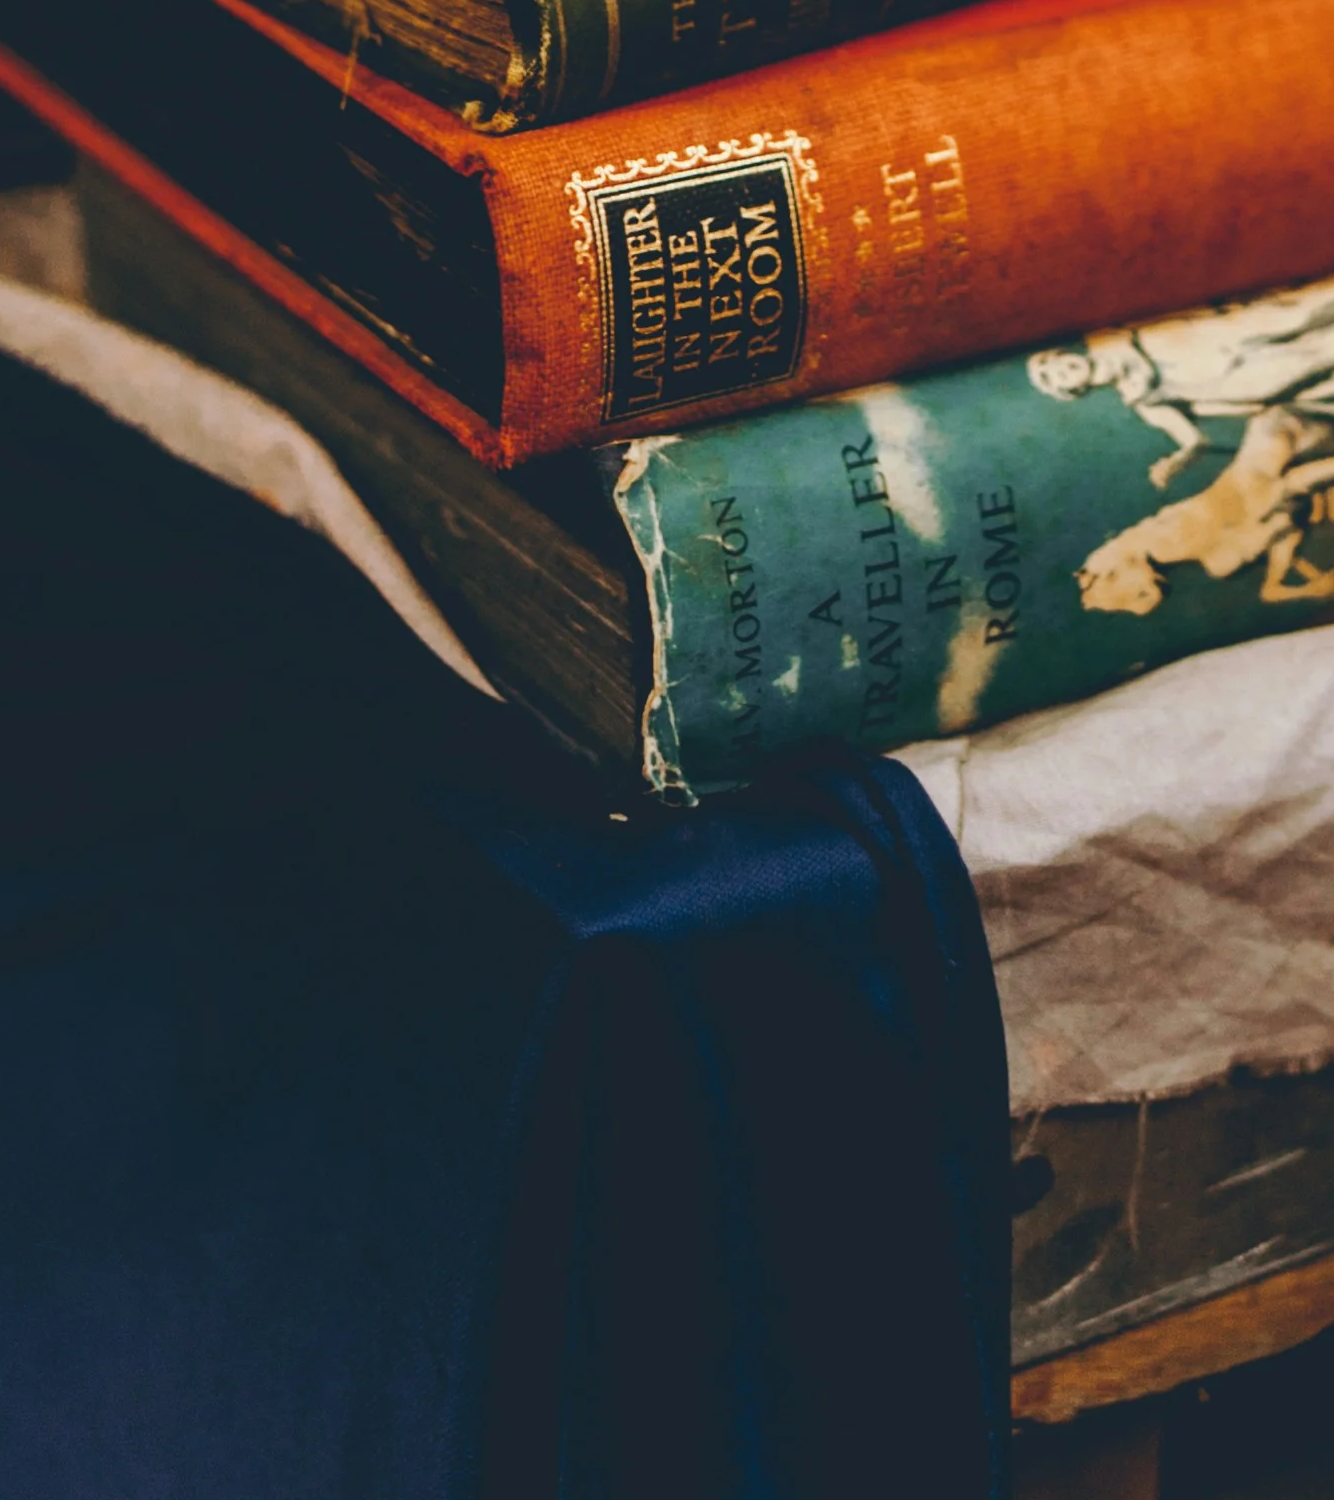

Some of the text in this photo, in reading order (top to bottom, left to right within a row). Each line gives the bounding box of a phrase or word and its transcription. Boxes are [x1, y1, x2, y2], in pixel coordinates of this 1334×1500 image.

[623, 195, 669, 406] LAUGHTER
[668, 228, 703, 374] IN THE
[701, 216, 745, 367] NEXT
[739, 199, 786, 363] ROOM
[710, 494, 764, 683] MORTON
[807, 589, 844, 628] A
[839, 432, 904, 736] TRAVELLER
[924, 553, 963, 615] IN
[975, 484, 1023, 647] ROME
